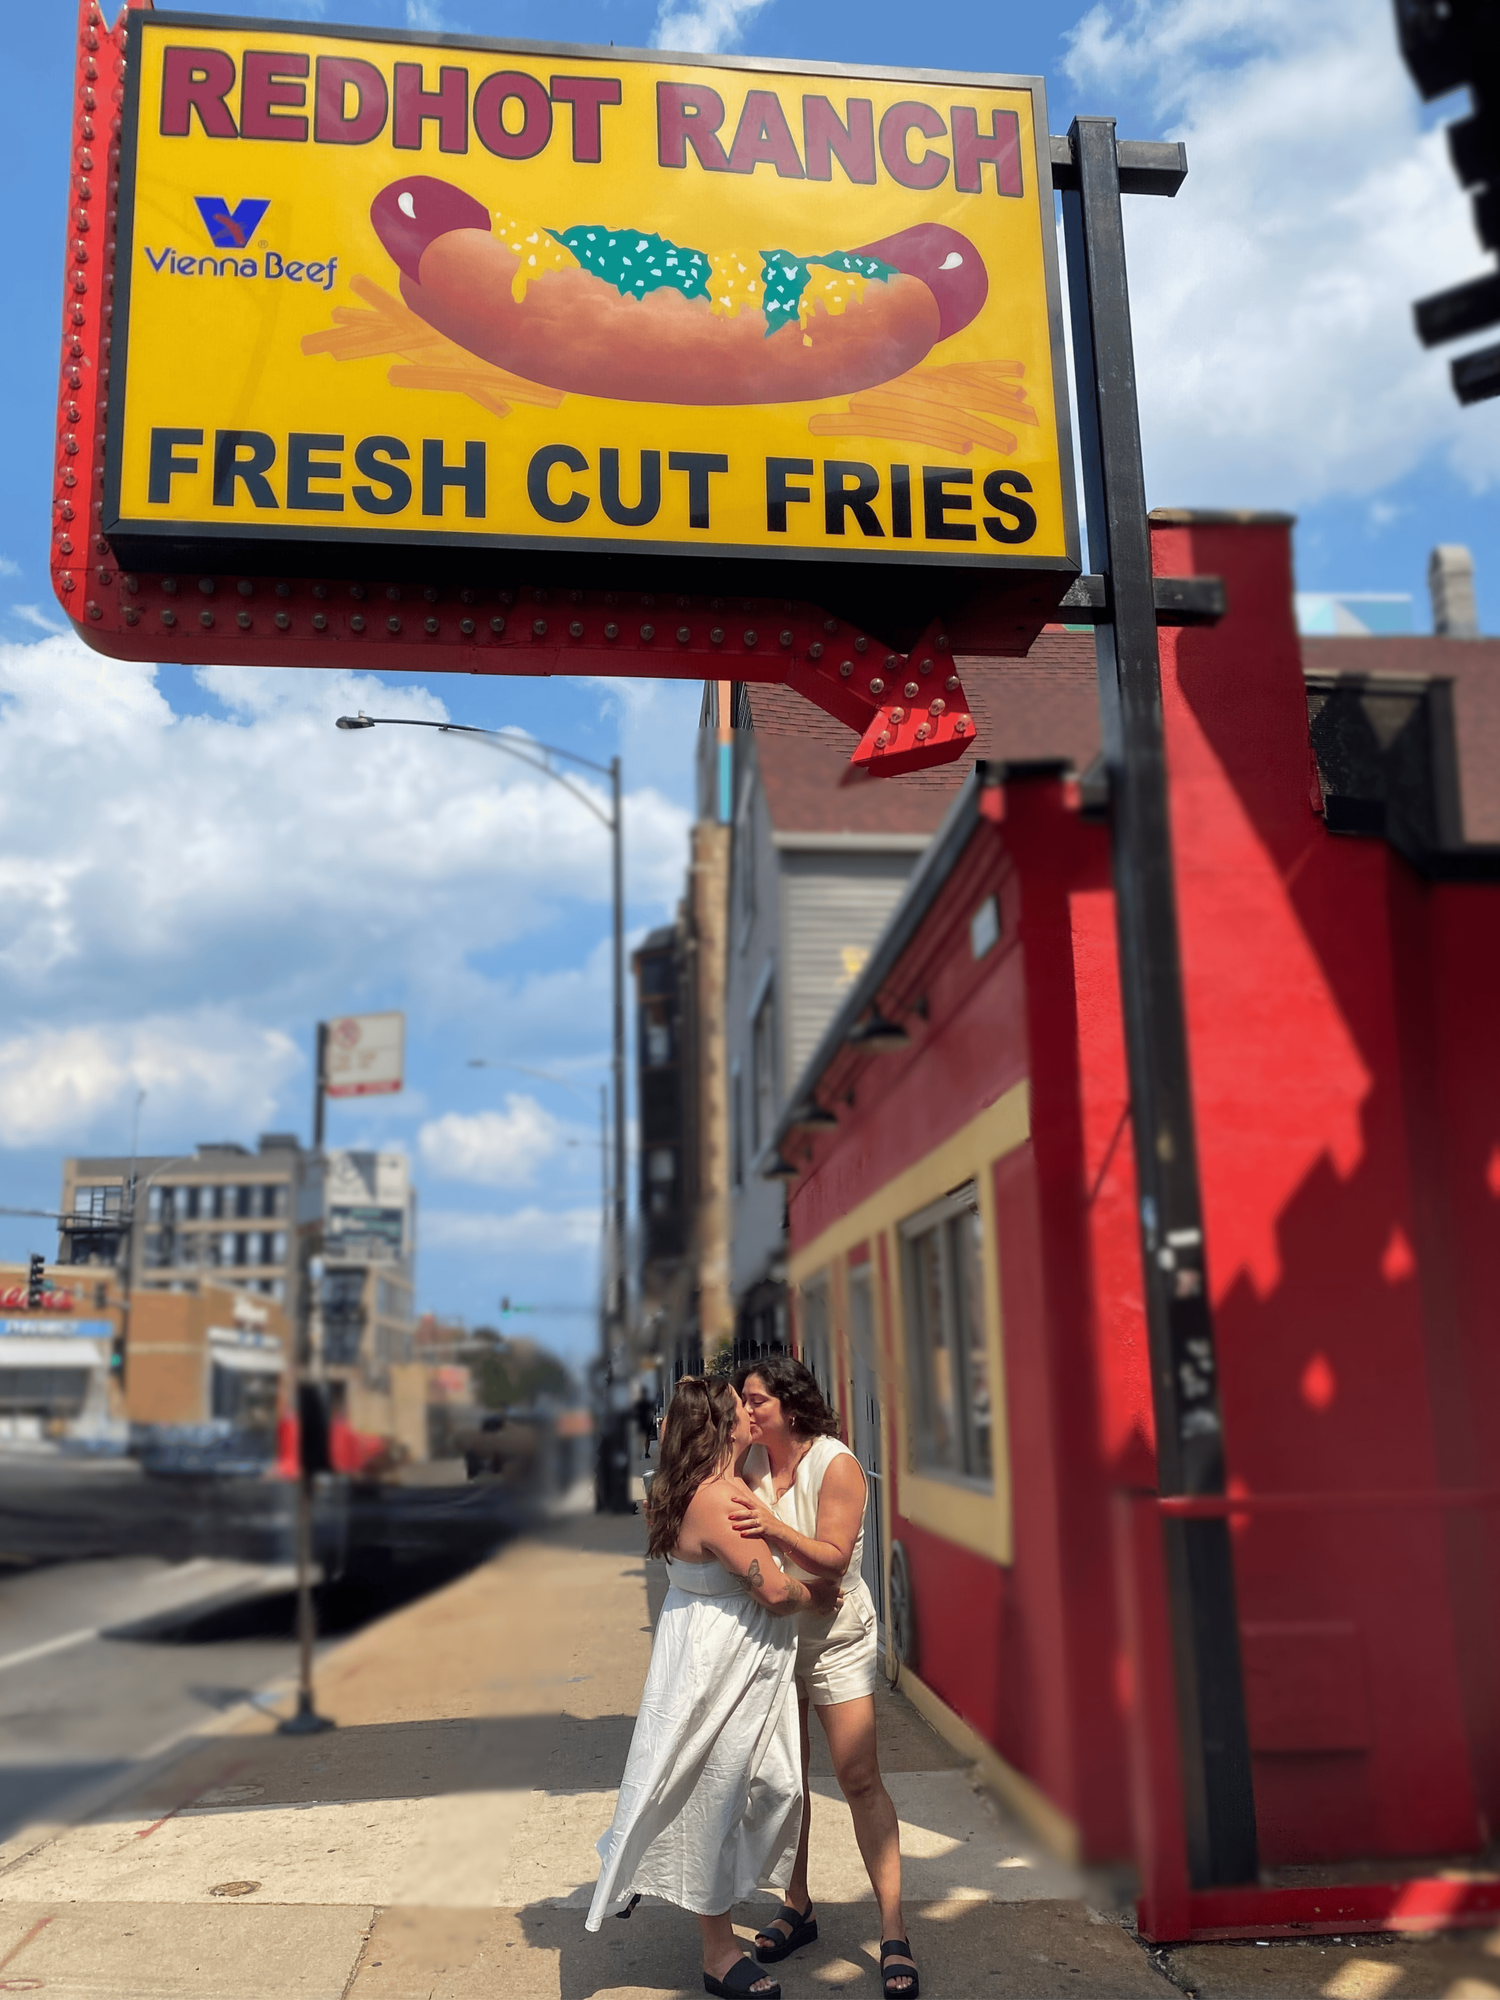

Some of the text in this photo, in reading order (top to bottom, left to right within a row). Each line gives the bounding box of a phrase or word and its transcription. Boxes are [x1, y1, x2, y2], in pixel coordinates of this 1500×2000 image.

[159, 46, 1024, 198] REDHOT RANCH
[145, 247, 337, 290] Vienna Beef
[148, 427, 1037, 544] FRESH CUT FRIES
